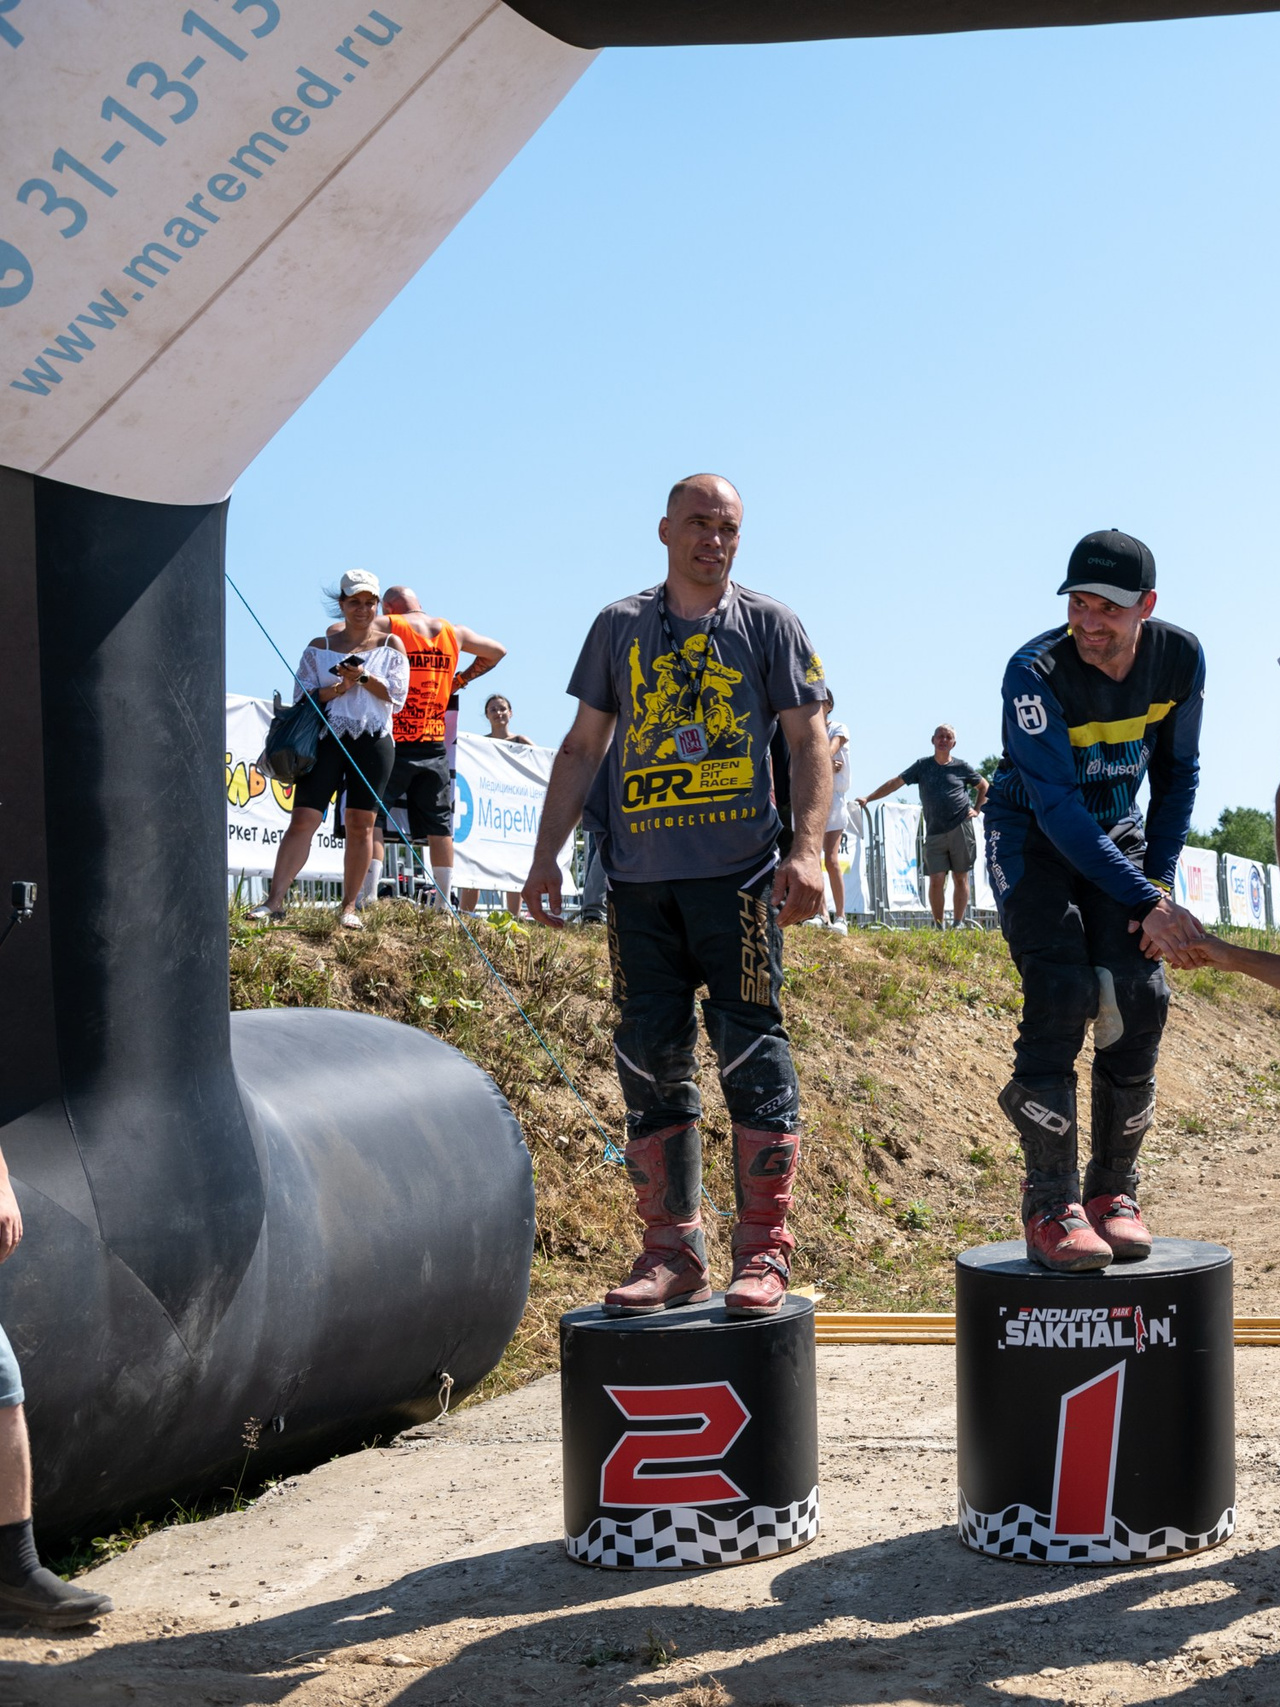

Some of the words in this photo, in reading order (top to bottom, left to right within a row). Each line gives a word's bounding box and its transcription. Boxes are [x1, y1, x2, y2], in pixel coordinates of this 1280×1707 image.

[10, 10, 402, 397] www.maremed.ru
[700, 770, 722, 780] PIT
[700, 777, 738, 788] RACE
[701, 760, 740, 772] OPEN
[479, 777, 529, 797] Медицинский
[622, 768, 693, 808] OPR
[478, 797, 541, 838] МареМ
[1006, 1306, 1171, 1353] SAKHALIN
[1018, 1308, 1109, 1322] ENDURO
[1112, 1307, 1131, 1317] PARK
[600, 1380, 752, 1510] 2
[1050, 1358, 1127, 1541] 1
